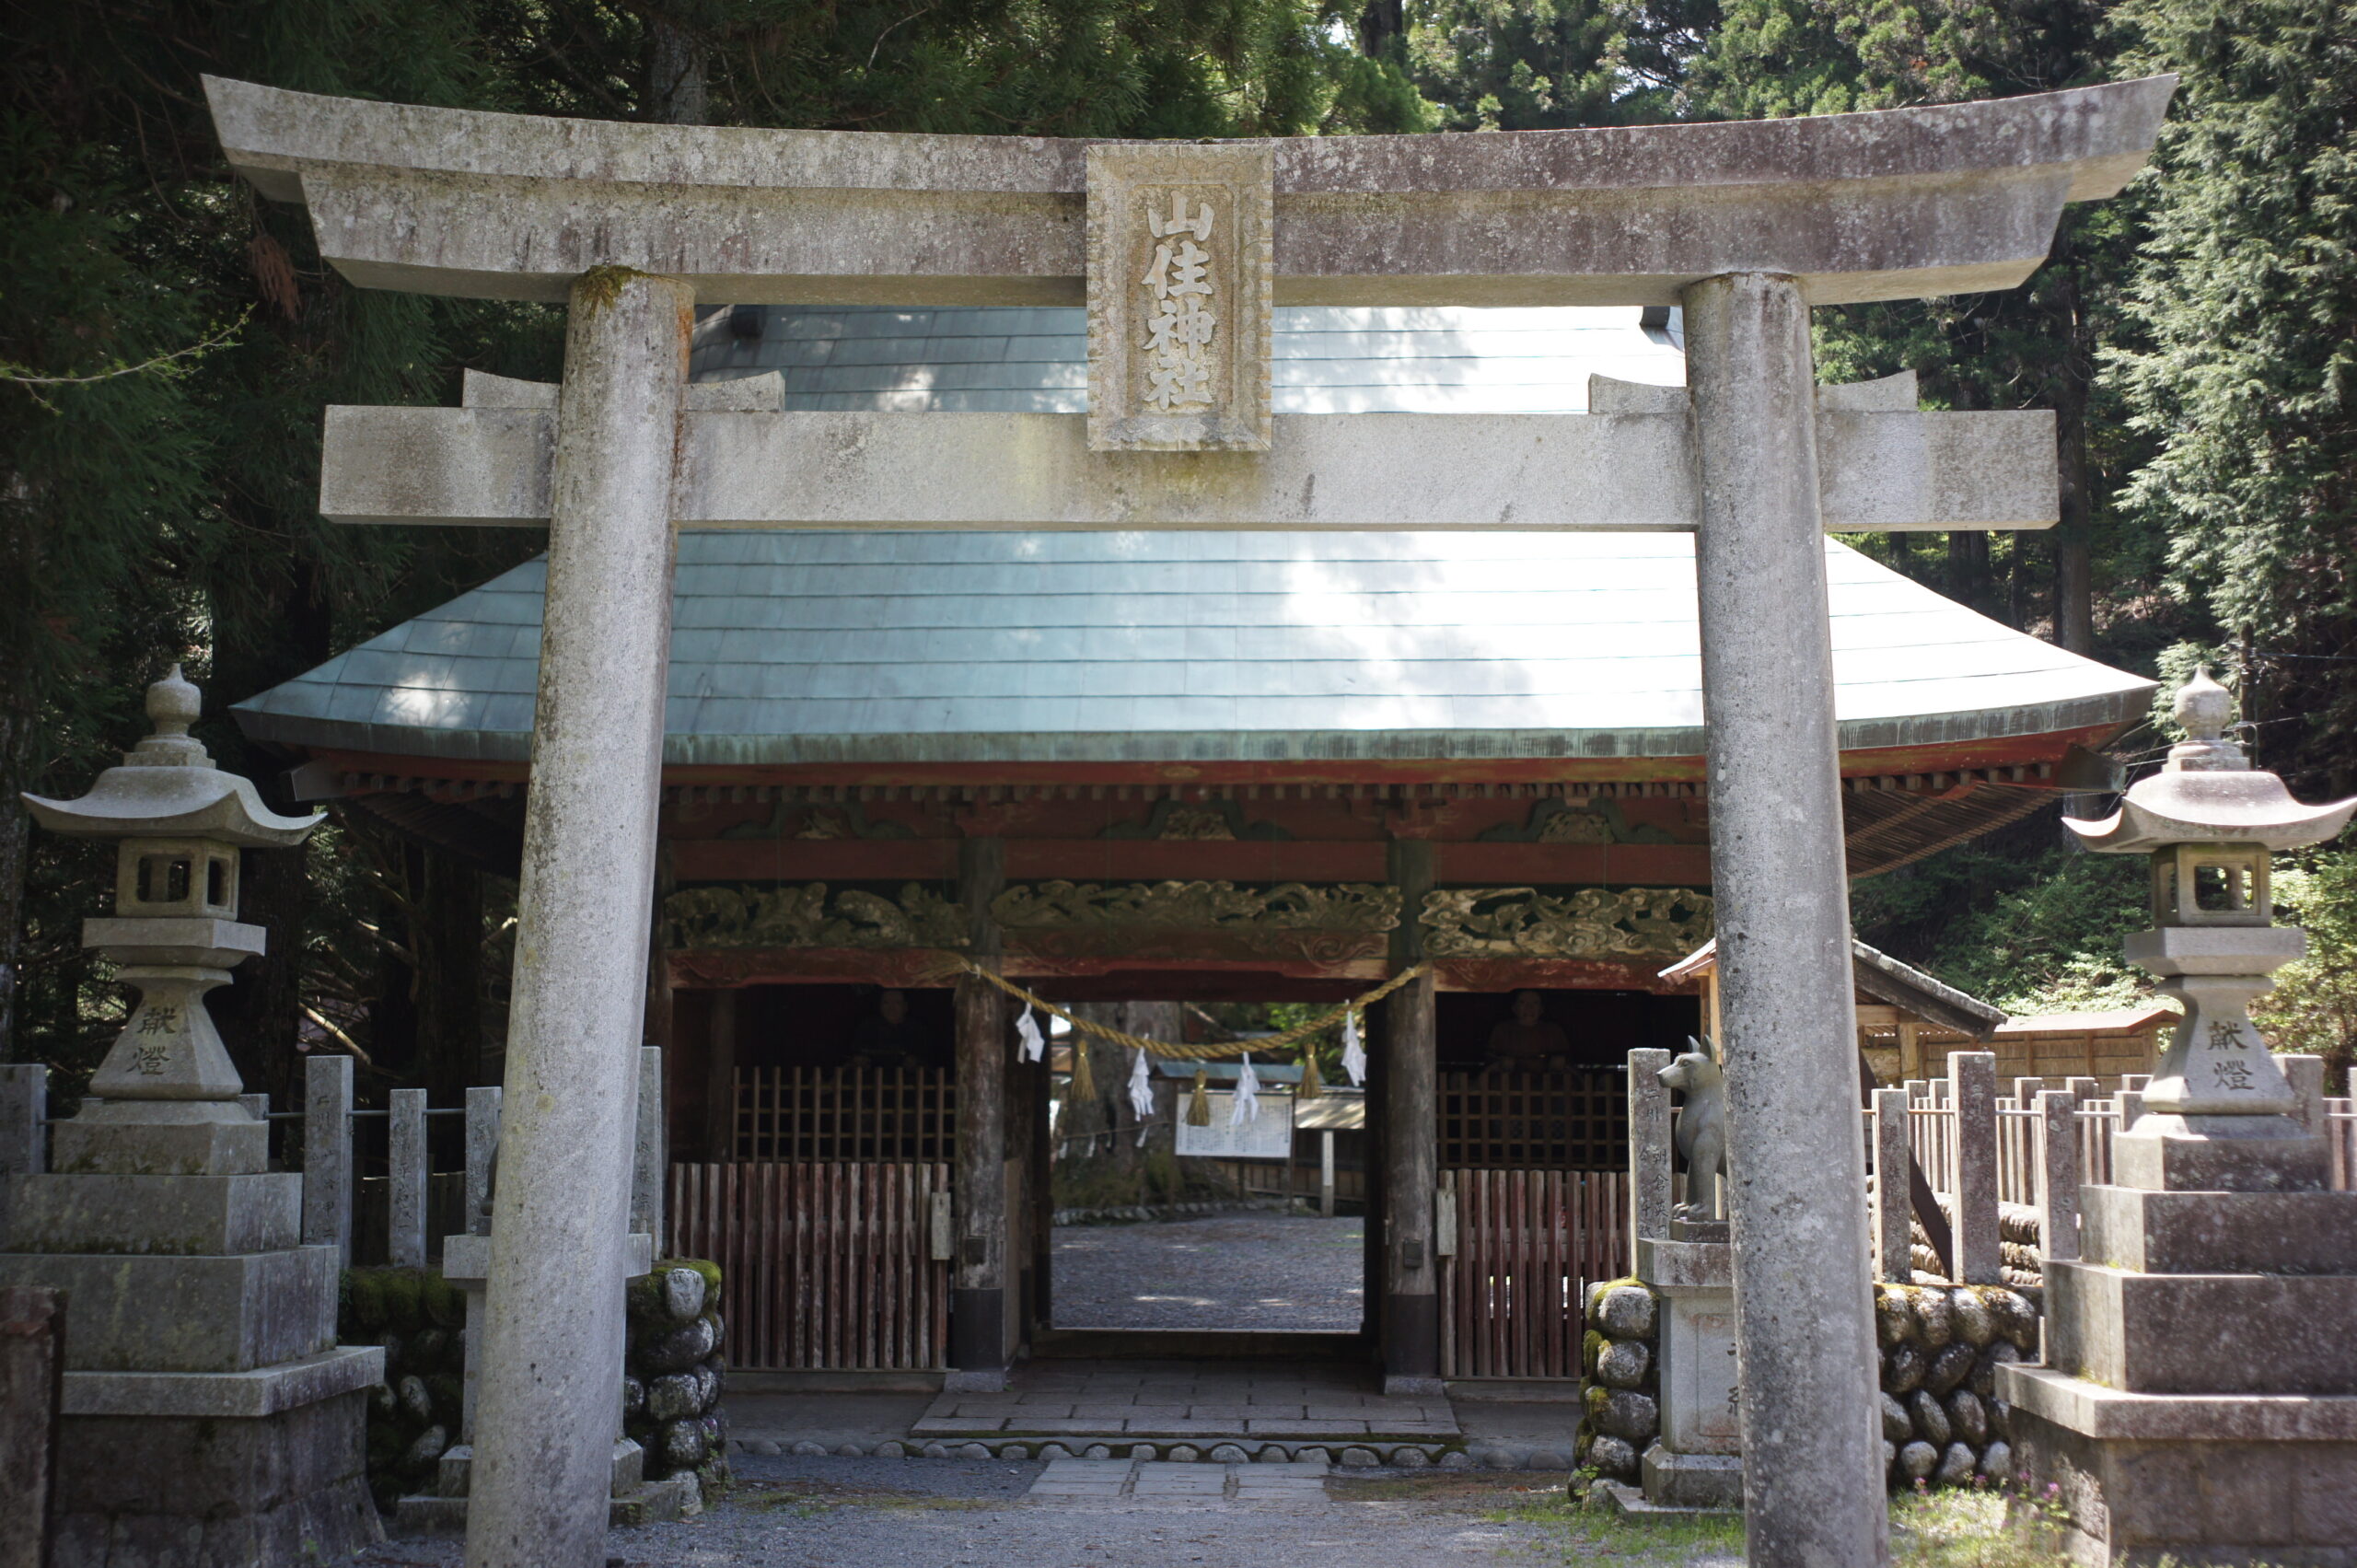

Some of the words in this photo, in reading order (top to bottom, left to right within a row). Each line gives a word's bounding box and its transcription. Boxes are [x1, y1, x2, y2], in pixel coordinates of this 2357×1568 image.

[1141, 190, 1216, 411] 山住神社
[126, 1006, 177, 1075] 献燈
[2207, 1020, 2256, 1090] 献燈
